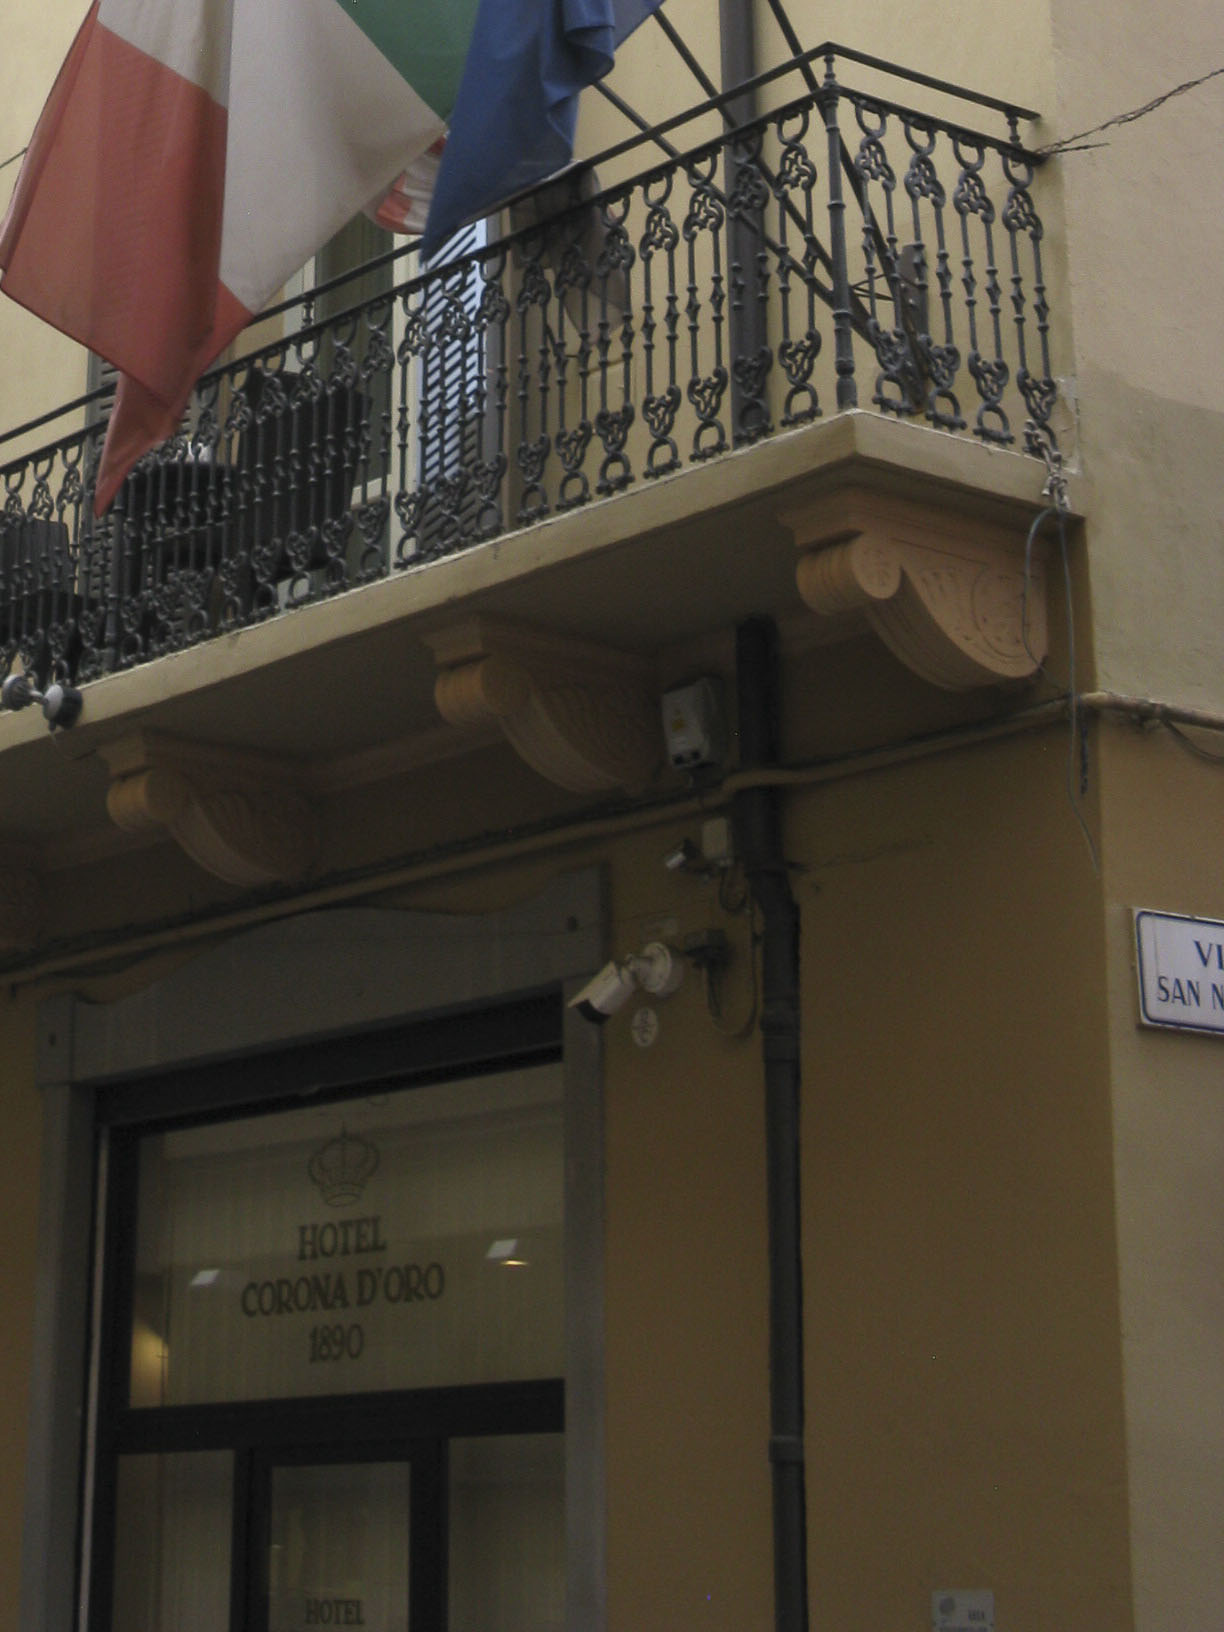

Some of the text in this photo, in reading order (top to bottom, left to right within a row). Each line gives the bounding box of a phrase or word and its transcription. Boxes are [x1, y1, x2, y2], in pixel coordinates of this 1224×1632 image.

[1157, 975, 1201, 1008] SAN
[297, 1215, 388, 1261] HOTEL
[240, 1262, 446, 1318] CORONA D'ORO
[308, 1323, 365, 1365] 1890
[303, 1599, 365, 1625] HOTEL
